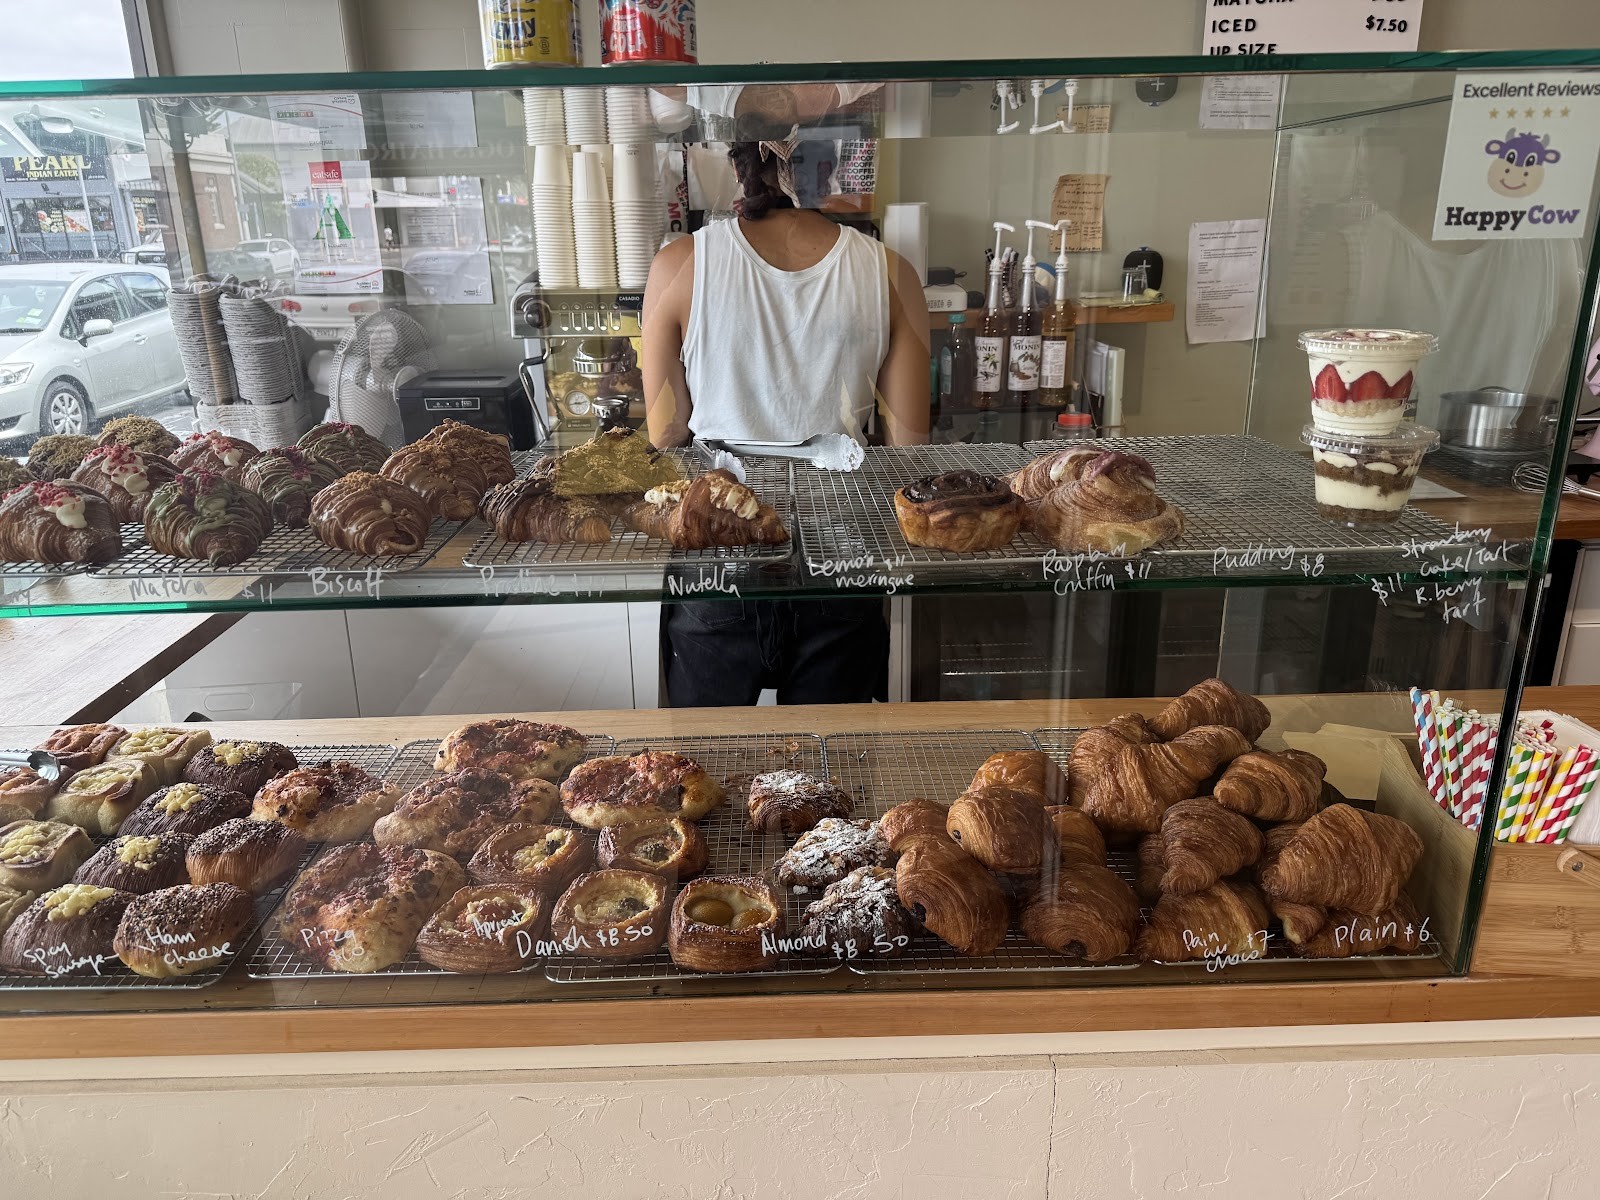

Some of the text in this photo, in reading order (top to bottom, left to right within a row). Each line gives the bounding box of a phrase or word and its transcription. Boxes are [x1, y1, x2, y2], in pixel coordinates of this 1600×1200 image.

[1212, 14, 1408, 33] ICED $7.50
[609, 30, 648, 53] COLA
[1210, 43, 1277, 56] UP SIZE
[1463, 81, 1600, 98] Excellent Reviews
[13, 155, 91, 171] PEARL
[26, 170, 53, 178] INDIAN
[1445, 204, 1580, 231] HappyCow
[1213, 537, 1325, 577] Pudding $8
[668, 566, 741, 598] Nutella
[836, 570, 914, 595] meringue
[1124, 561, 1152, 580] $11
[129, 571, 274, 605] Matcha $11
[1371, 572, 1404, 606] $11
[145, 926, 195, 947] Ham
[1182, 927, 1275, 951] Pain $7
[1404, 916, 1430, 942] $6
[516, 925, 653, 958] Danish $8.50
[761, 926, 827, 957] Almond
